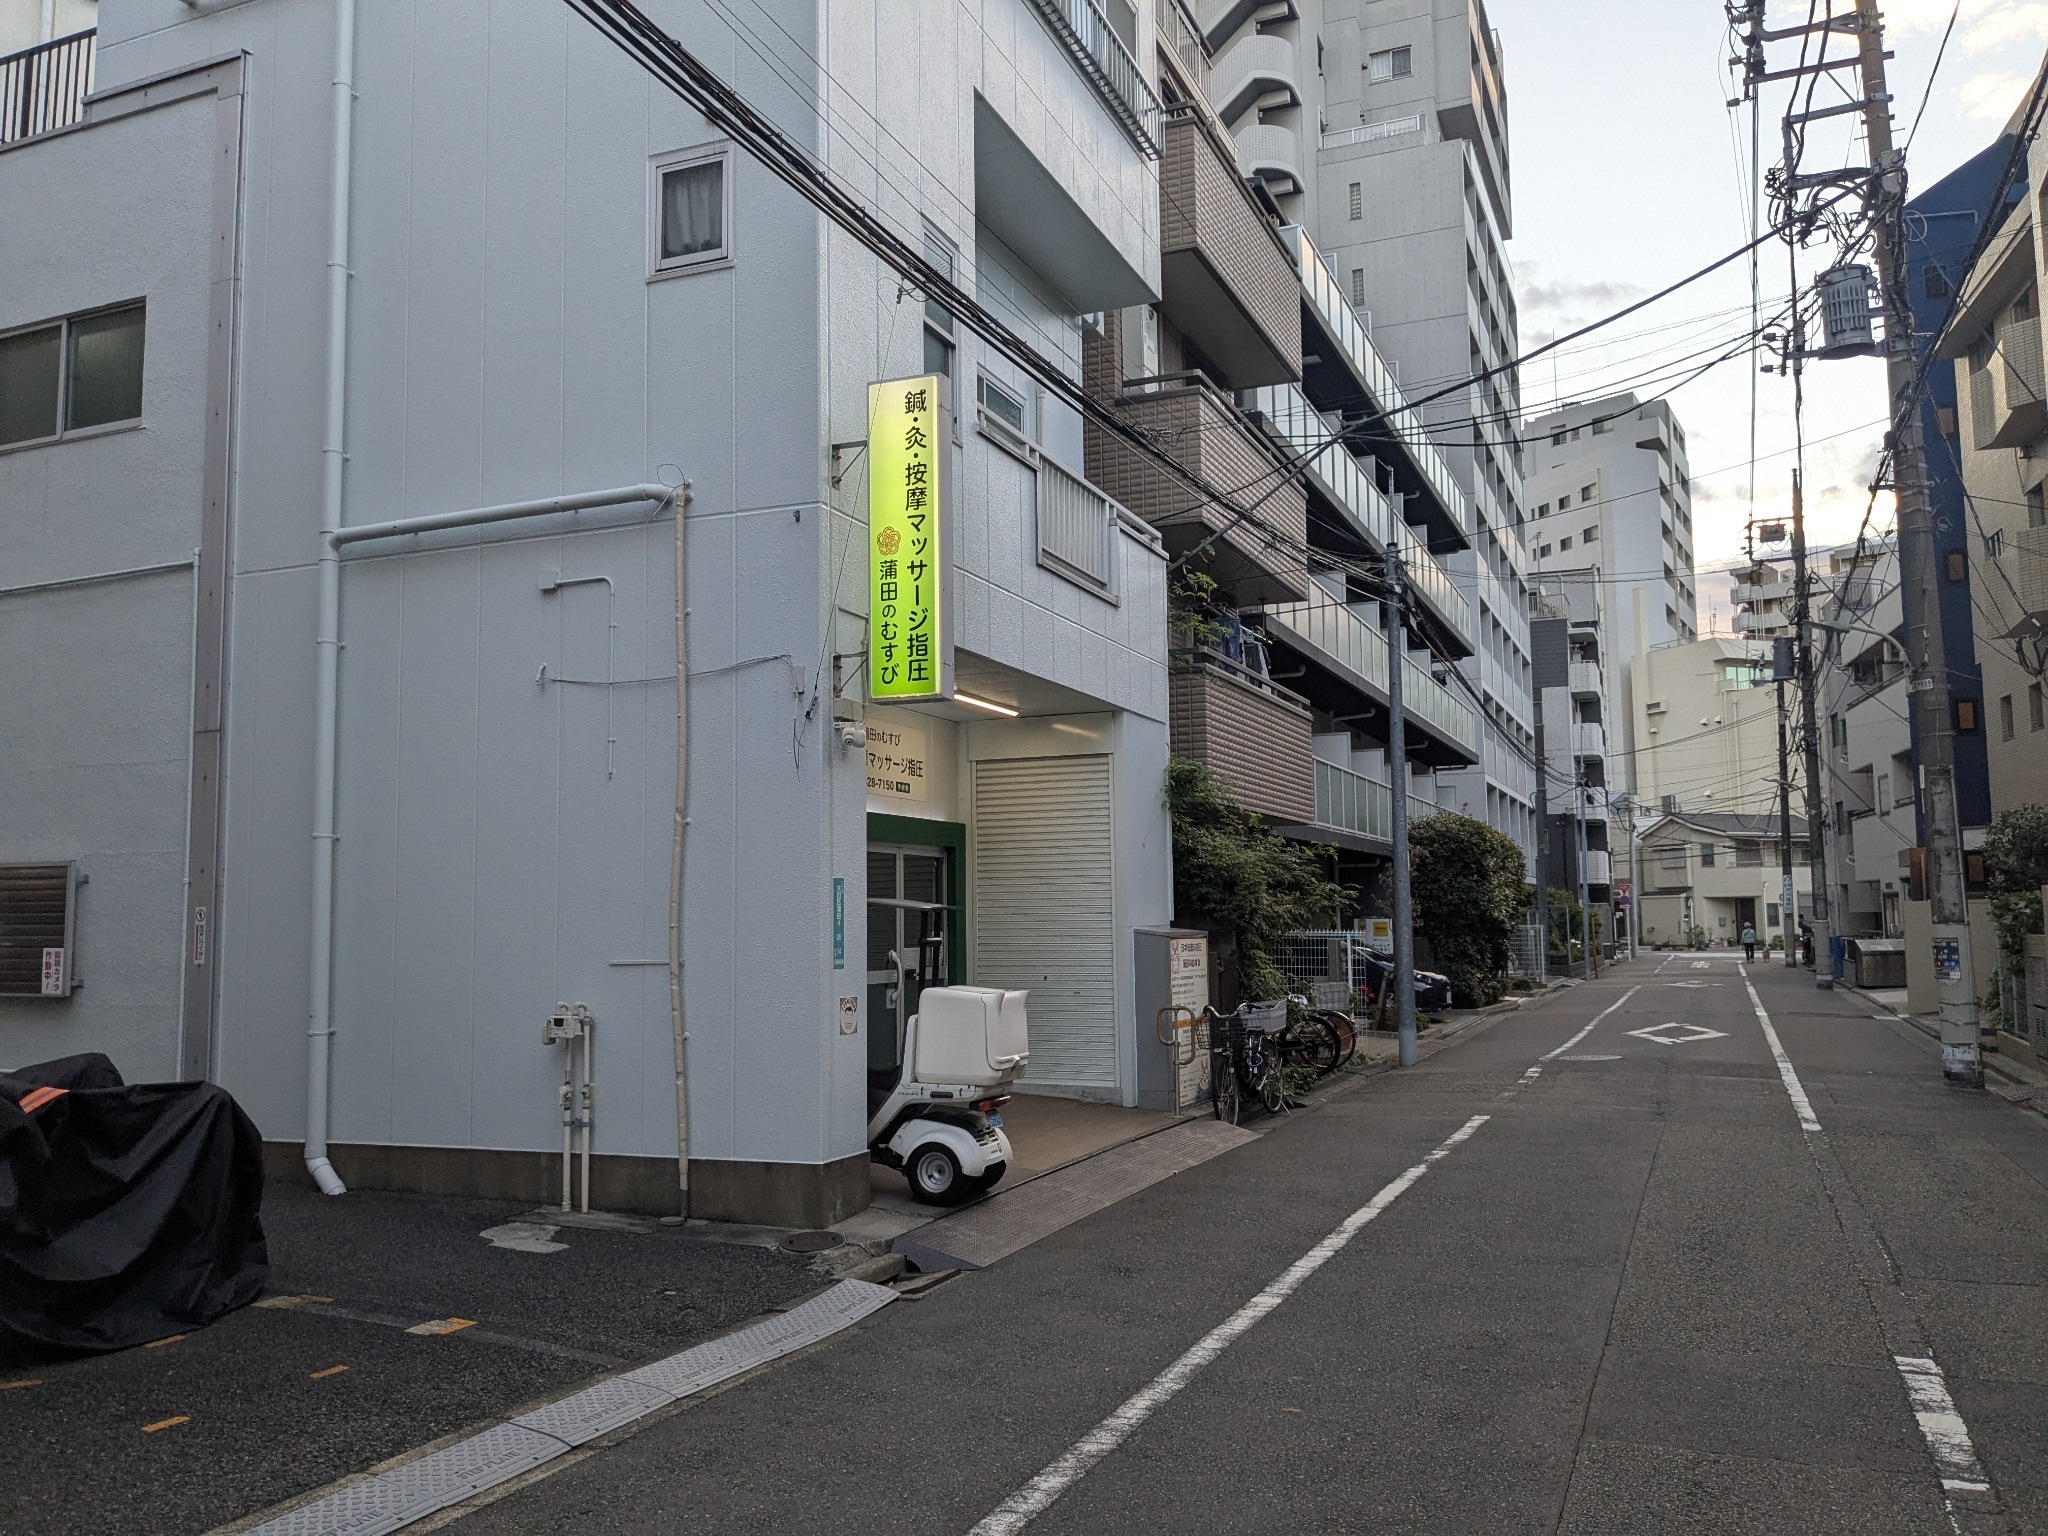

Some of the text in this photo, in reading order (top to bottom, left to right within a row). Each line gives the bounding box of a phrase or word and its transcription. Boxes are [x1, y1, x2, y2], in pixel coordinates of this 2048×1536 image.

[905, 389, 929, 682] 鍼・灸・按摩マッサージ指圧
[879, 559, 899, 684] 蒲田のむすび
[866, 750, 923, 777] マッサージ指圧
[866, 777, 894, 790] 28-7150
